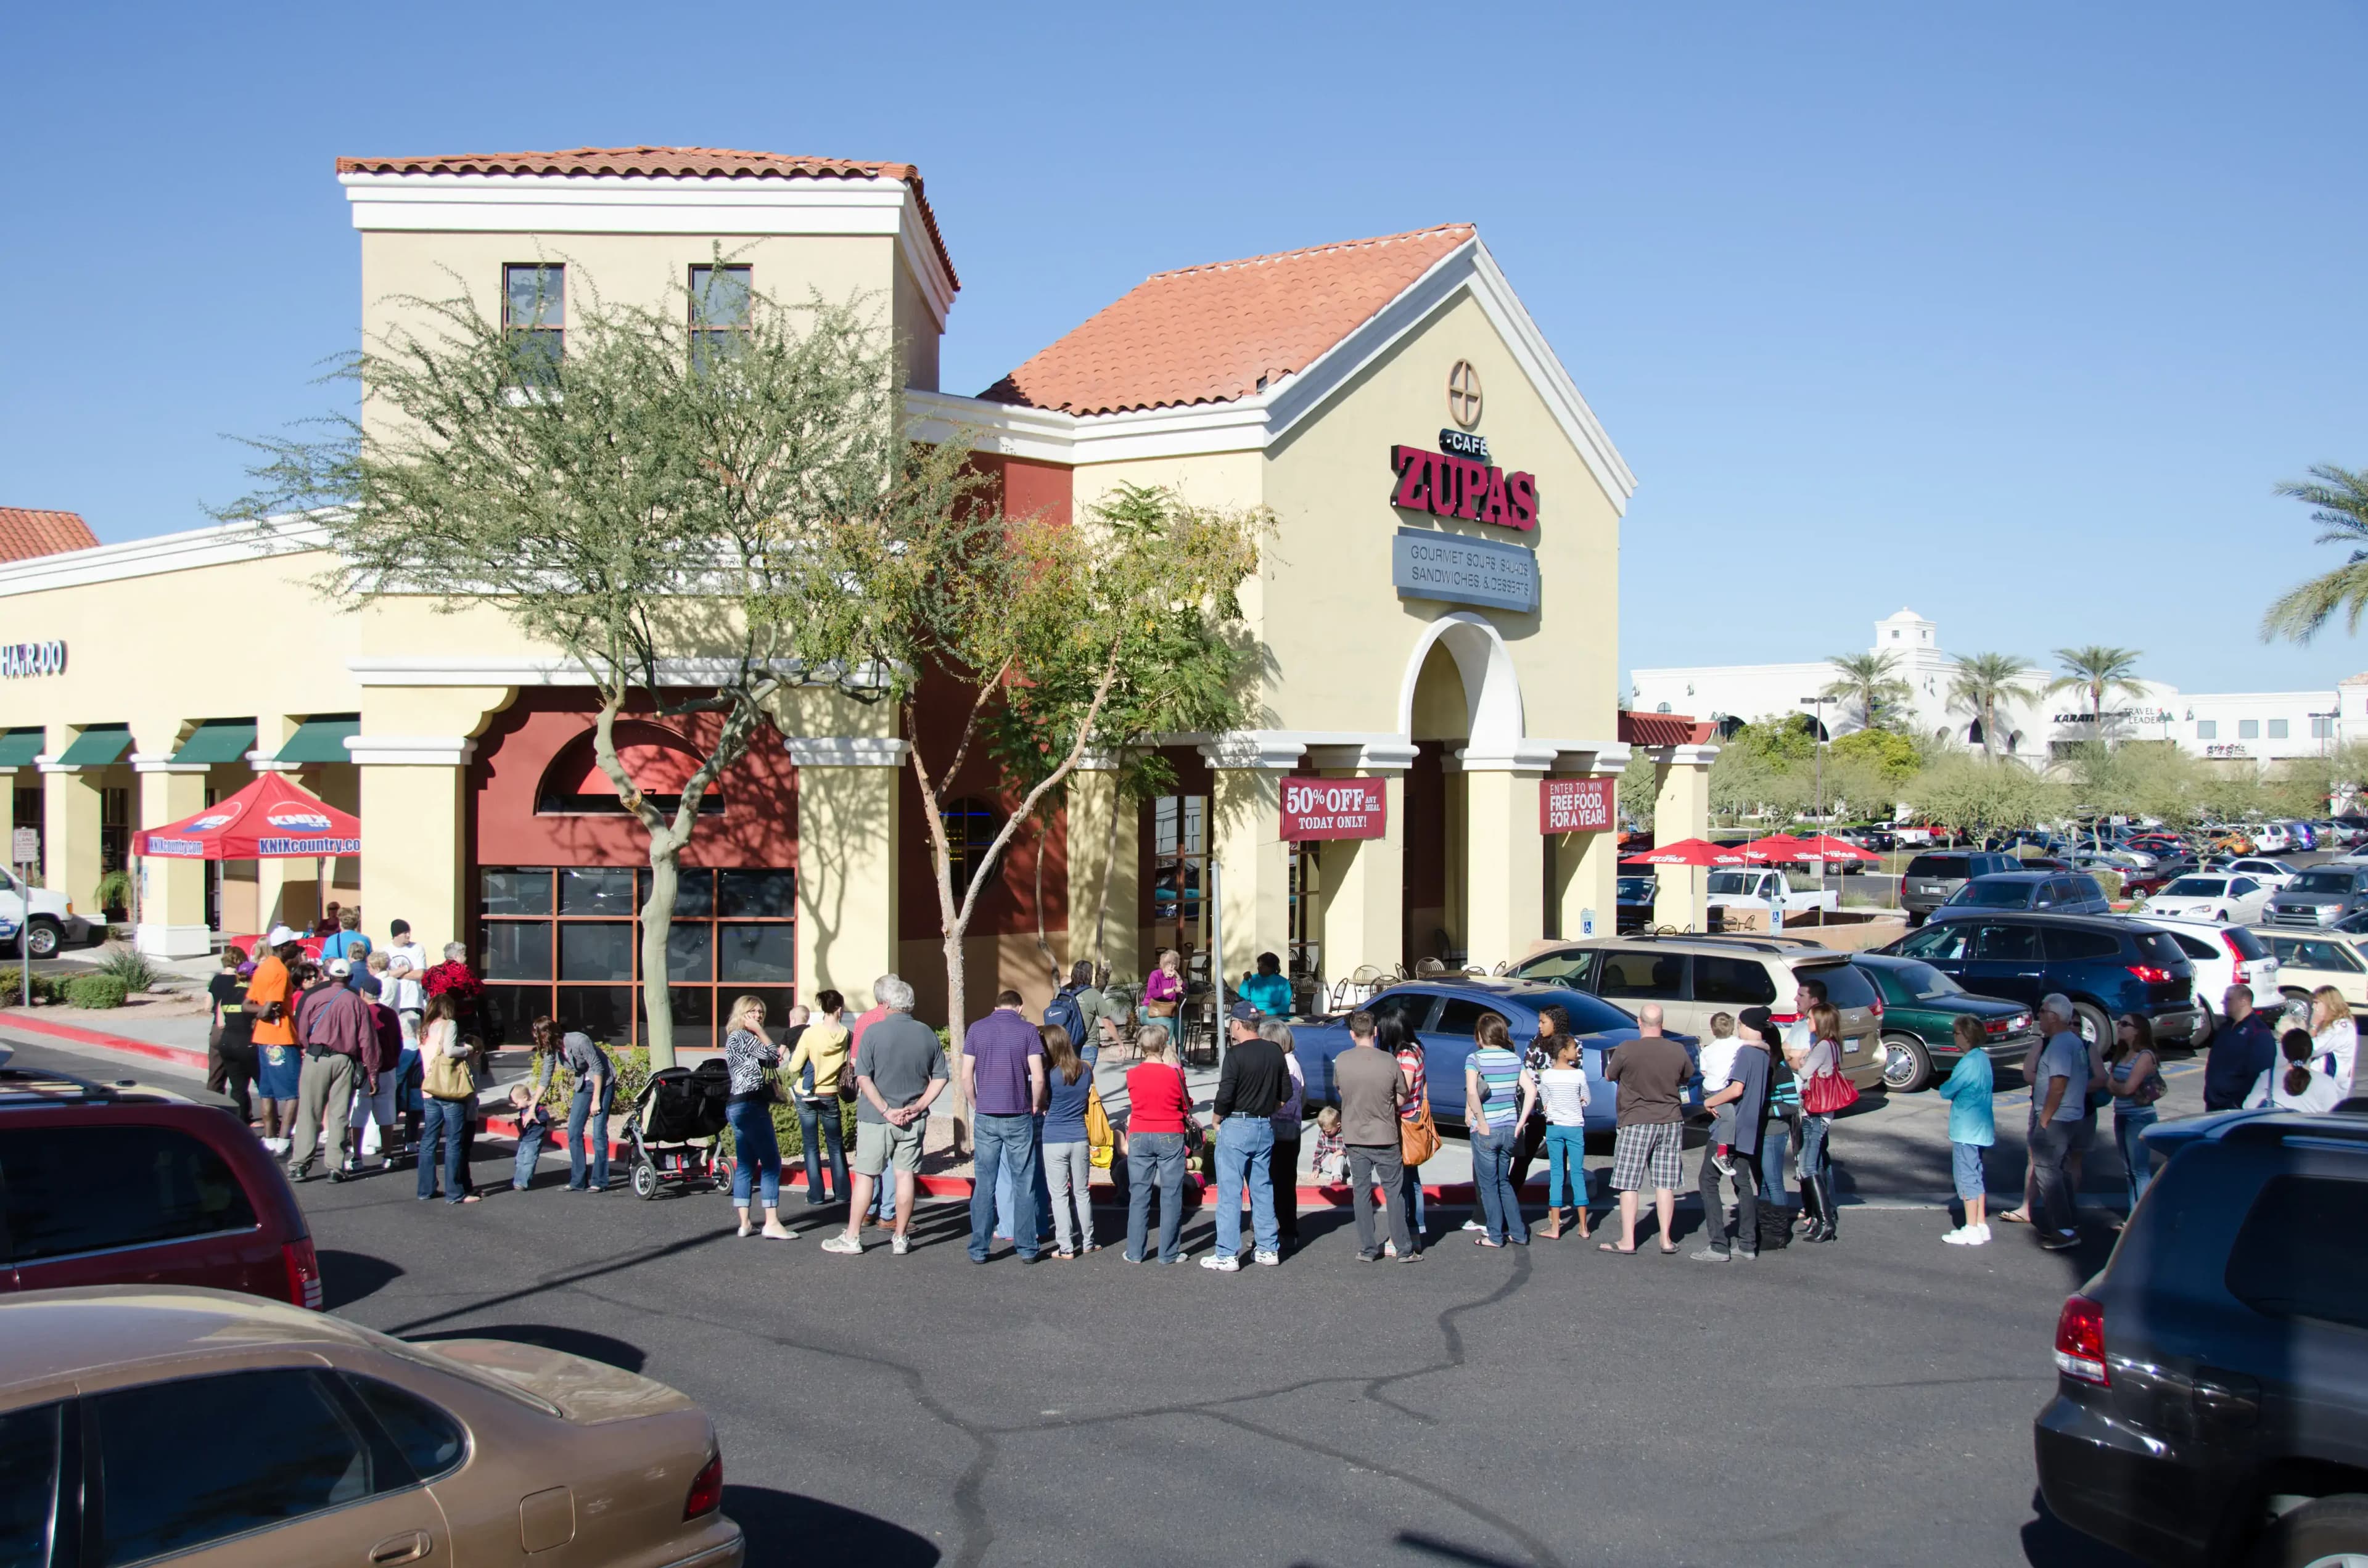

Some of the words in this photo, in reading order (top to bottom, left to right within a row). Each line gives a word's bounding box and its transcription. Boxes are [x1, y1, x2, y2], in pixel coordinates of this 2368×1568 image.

[1396, 445, 1537, 532] ZUPAS
[1411, 545, 1463, 565] GOURMET
[1484, 576, 1490, 589] &
[1492, 577, 1529, 596] DESSERTS
[2123, 707, 2155, 715] TRAVEL
[1550, 783, 1573, 795] ENTER
[1576, 782, 1586, 793] TO
[1588, 781, 1602, 792] WIN
[1286, 787, 1325, 814] 50%
[1326, 788, 1364, 812] OFF
[1550, 794, 1573, 811] FREE
[1574, 793, 1602, 810] FOOD
[266, 814, 332, 825] KNIX
[1298, 816, 1334, 829] TODAY
[1337, 815, 1367, 828] ONLY!
[1550, 811, 1570, 828] FOR
[1571, 810, 1578, 826] A
[1579, 805, 1606, 826] YEAR!
[259, 837, 361, 854] KNIXcountry.co
